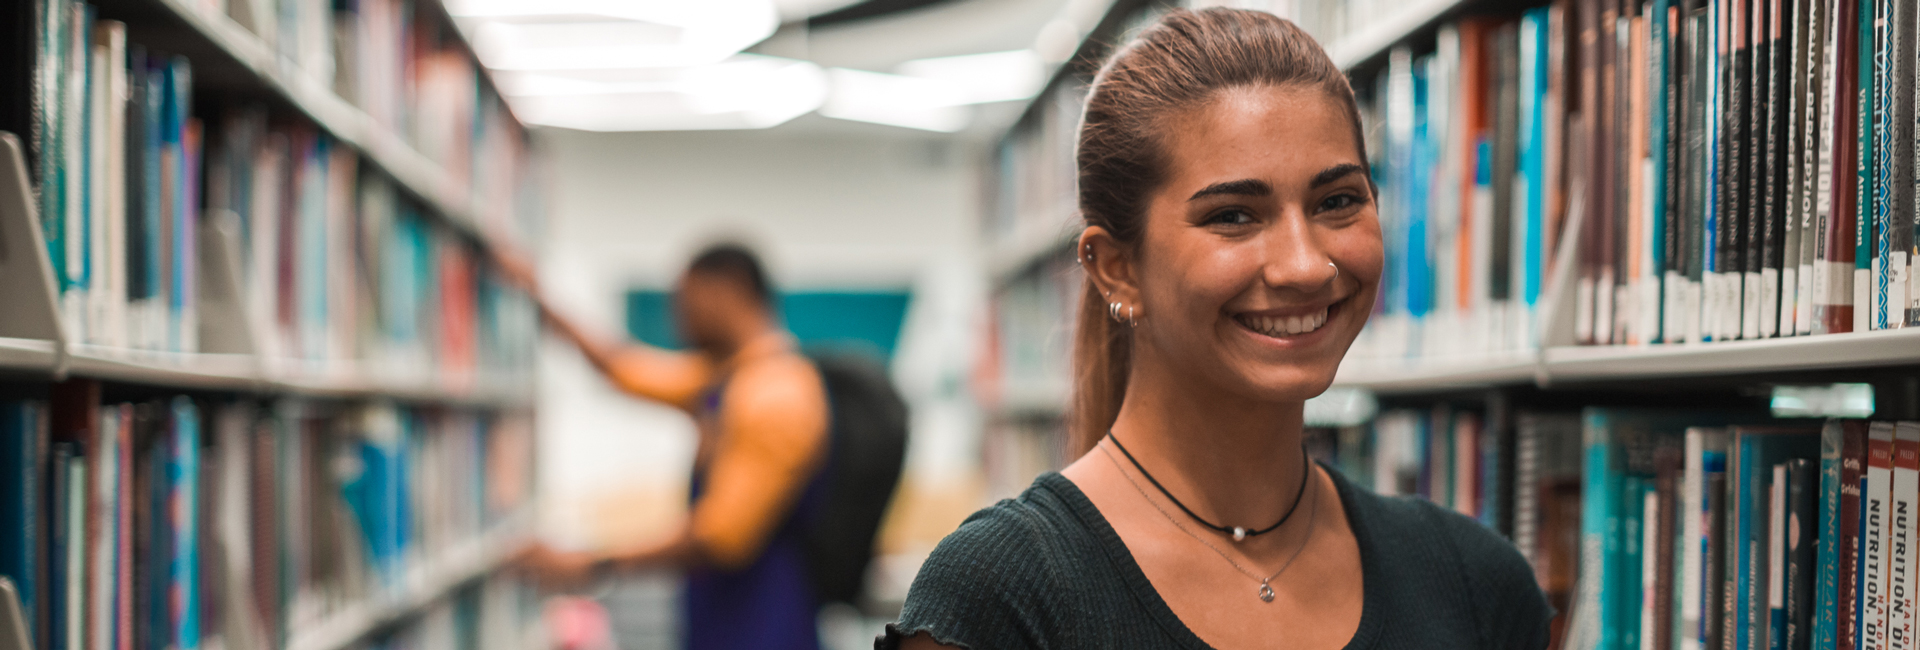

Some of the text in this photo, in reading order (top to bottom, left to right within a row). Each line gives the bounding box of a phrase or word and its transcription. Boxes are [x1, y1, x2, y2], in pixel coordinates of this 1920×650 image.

[1786, 97, 1797, 231] PERCEPTION
[1802, 92, 1815, 228] PERCEPTION
[1858, 88, 1866, 137] Vision
[1872, 51, 1884, 227] Visual Perception
[1857, 175, 1865, 247] Attention
[1825, 490, 1836, 623] BINOCULAR
[1841, 534, 1850, 612] Diagnosis
[1848, 535, 1859, 645] Binocular
[1865, 499, 1880, 613] NUTRITION,
[1892, 501, 1908, 617] NUTRITION,
